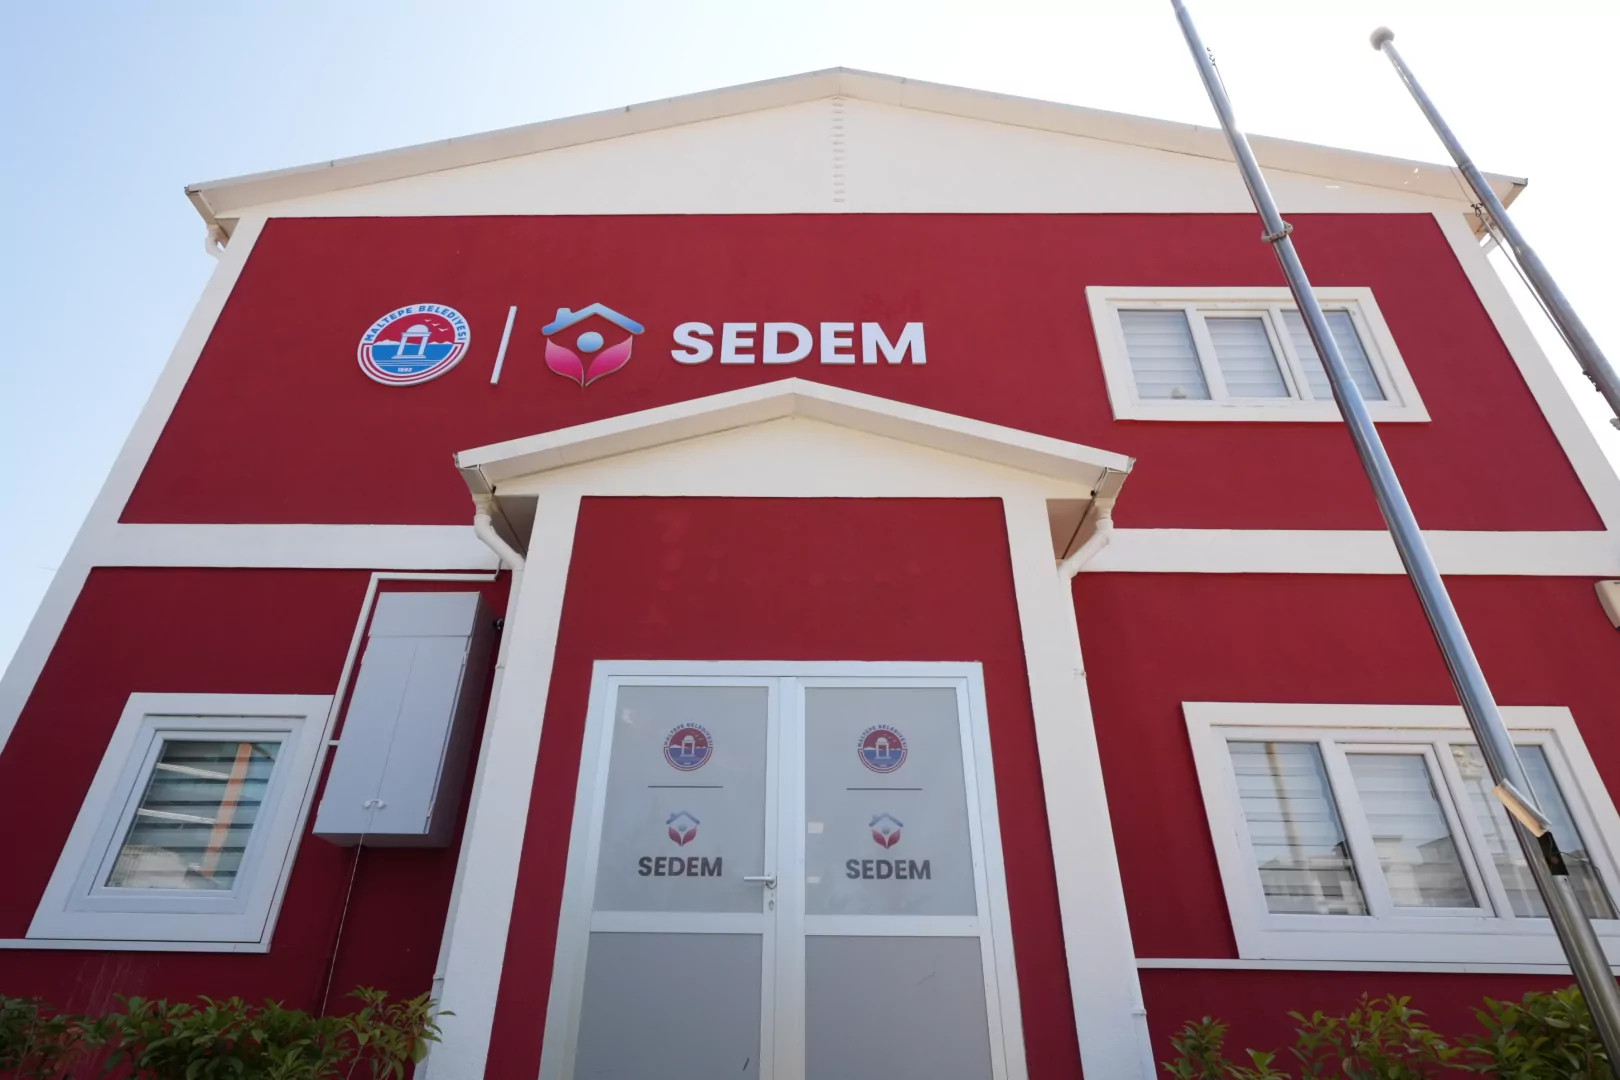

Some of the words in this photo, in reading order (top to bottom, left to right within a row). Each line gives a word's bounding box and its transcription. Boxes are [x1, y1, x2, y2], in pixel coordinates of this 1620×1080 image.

[364, 307, 413, 342] MALTEPE
[671, 321, 928, 365] SEDEM
[638, 856, 723, 877] SEDEM
[846, 858, 931, 880] SEDEM
